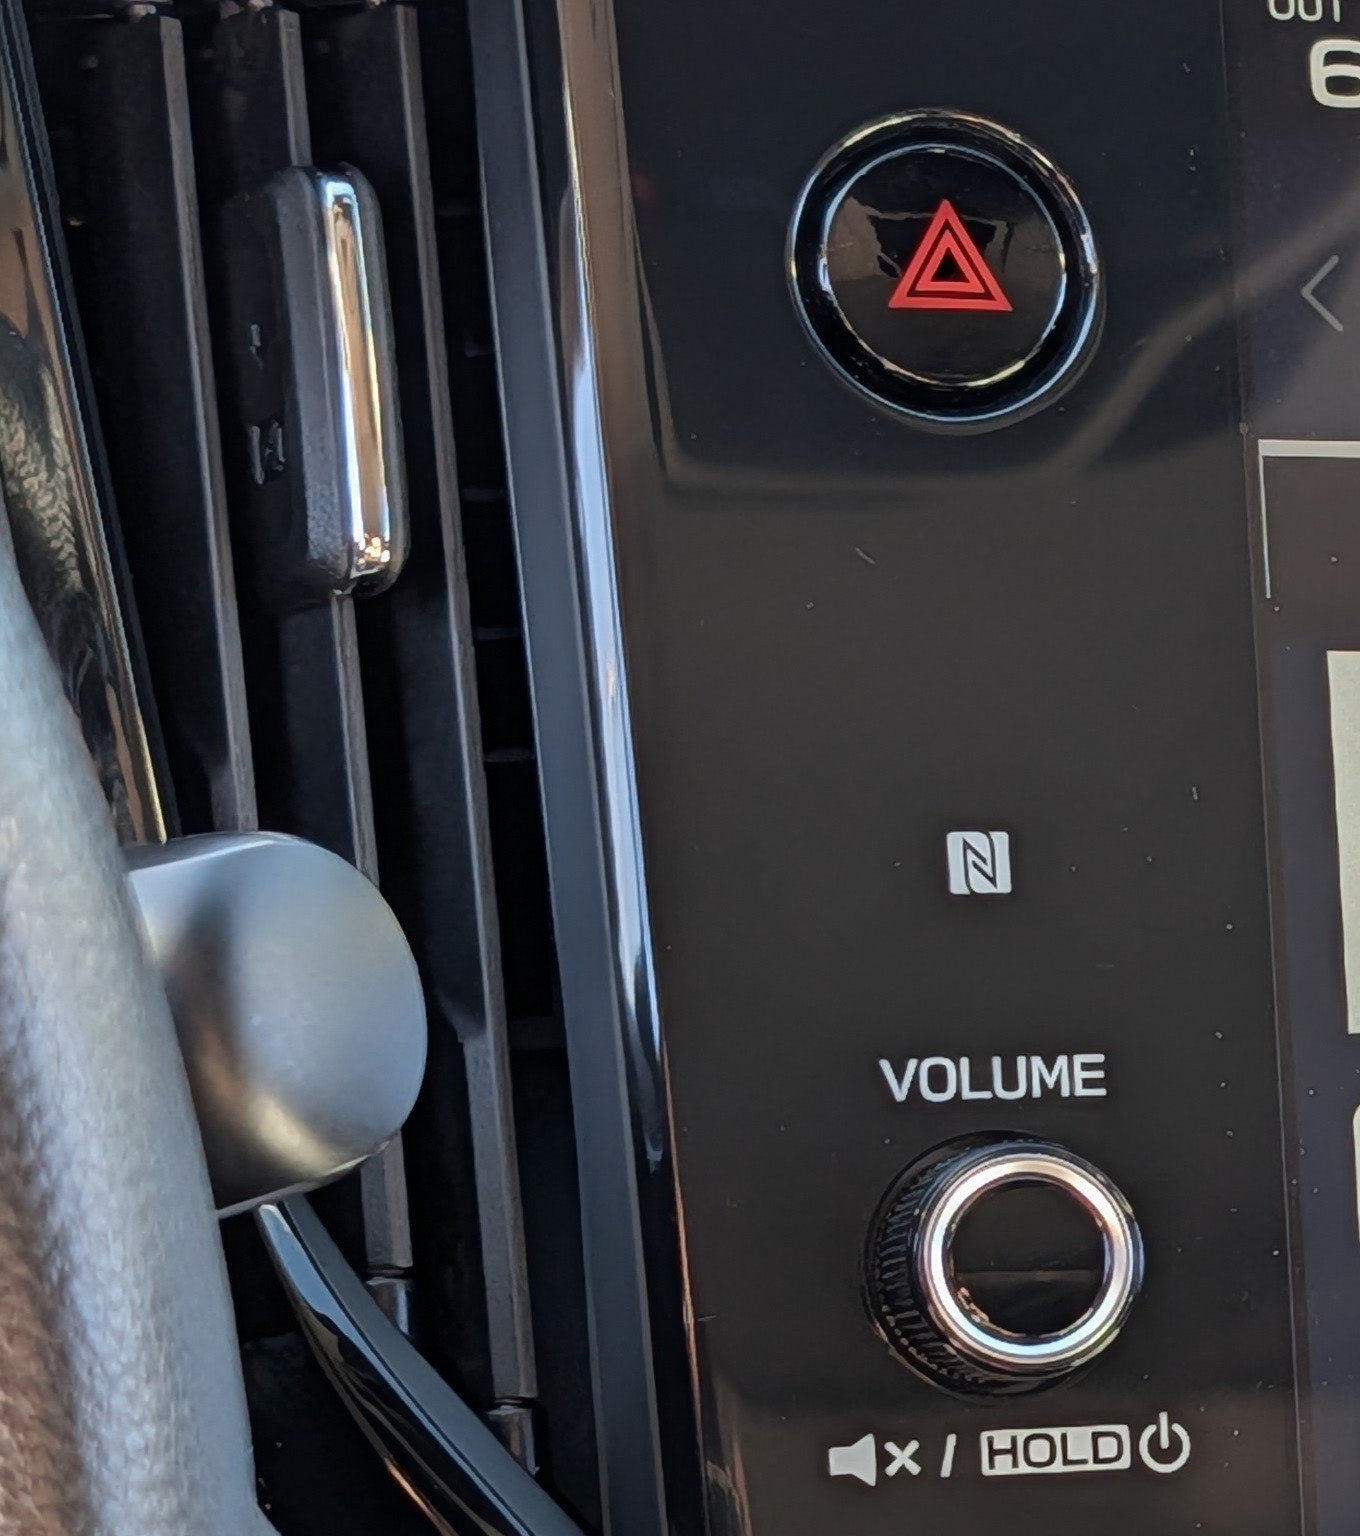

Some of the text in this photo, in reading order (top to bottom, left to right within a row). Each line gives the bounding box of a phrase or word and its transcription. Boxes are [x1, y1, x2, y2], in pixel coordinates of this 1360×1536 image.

[1267, 0, 1341, 23] OUT
[878, 1053, 1108, 1103] VOLUME
[984, 1428, 1127, 1473] HOLD
